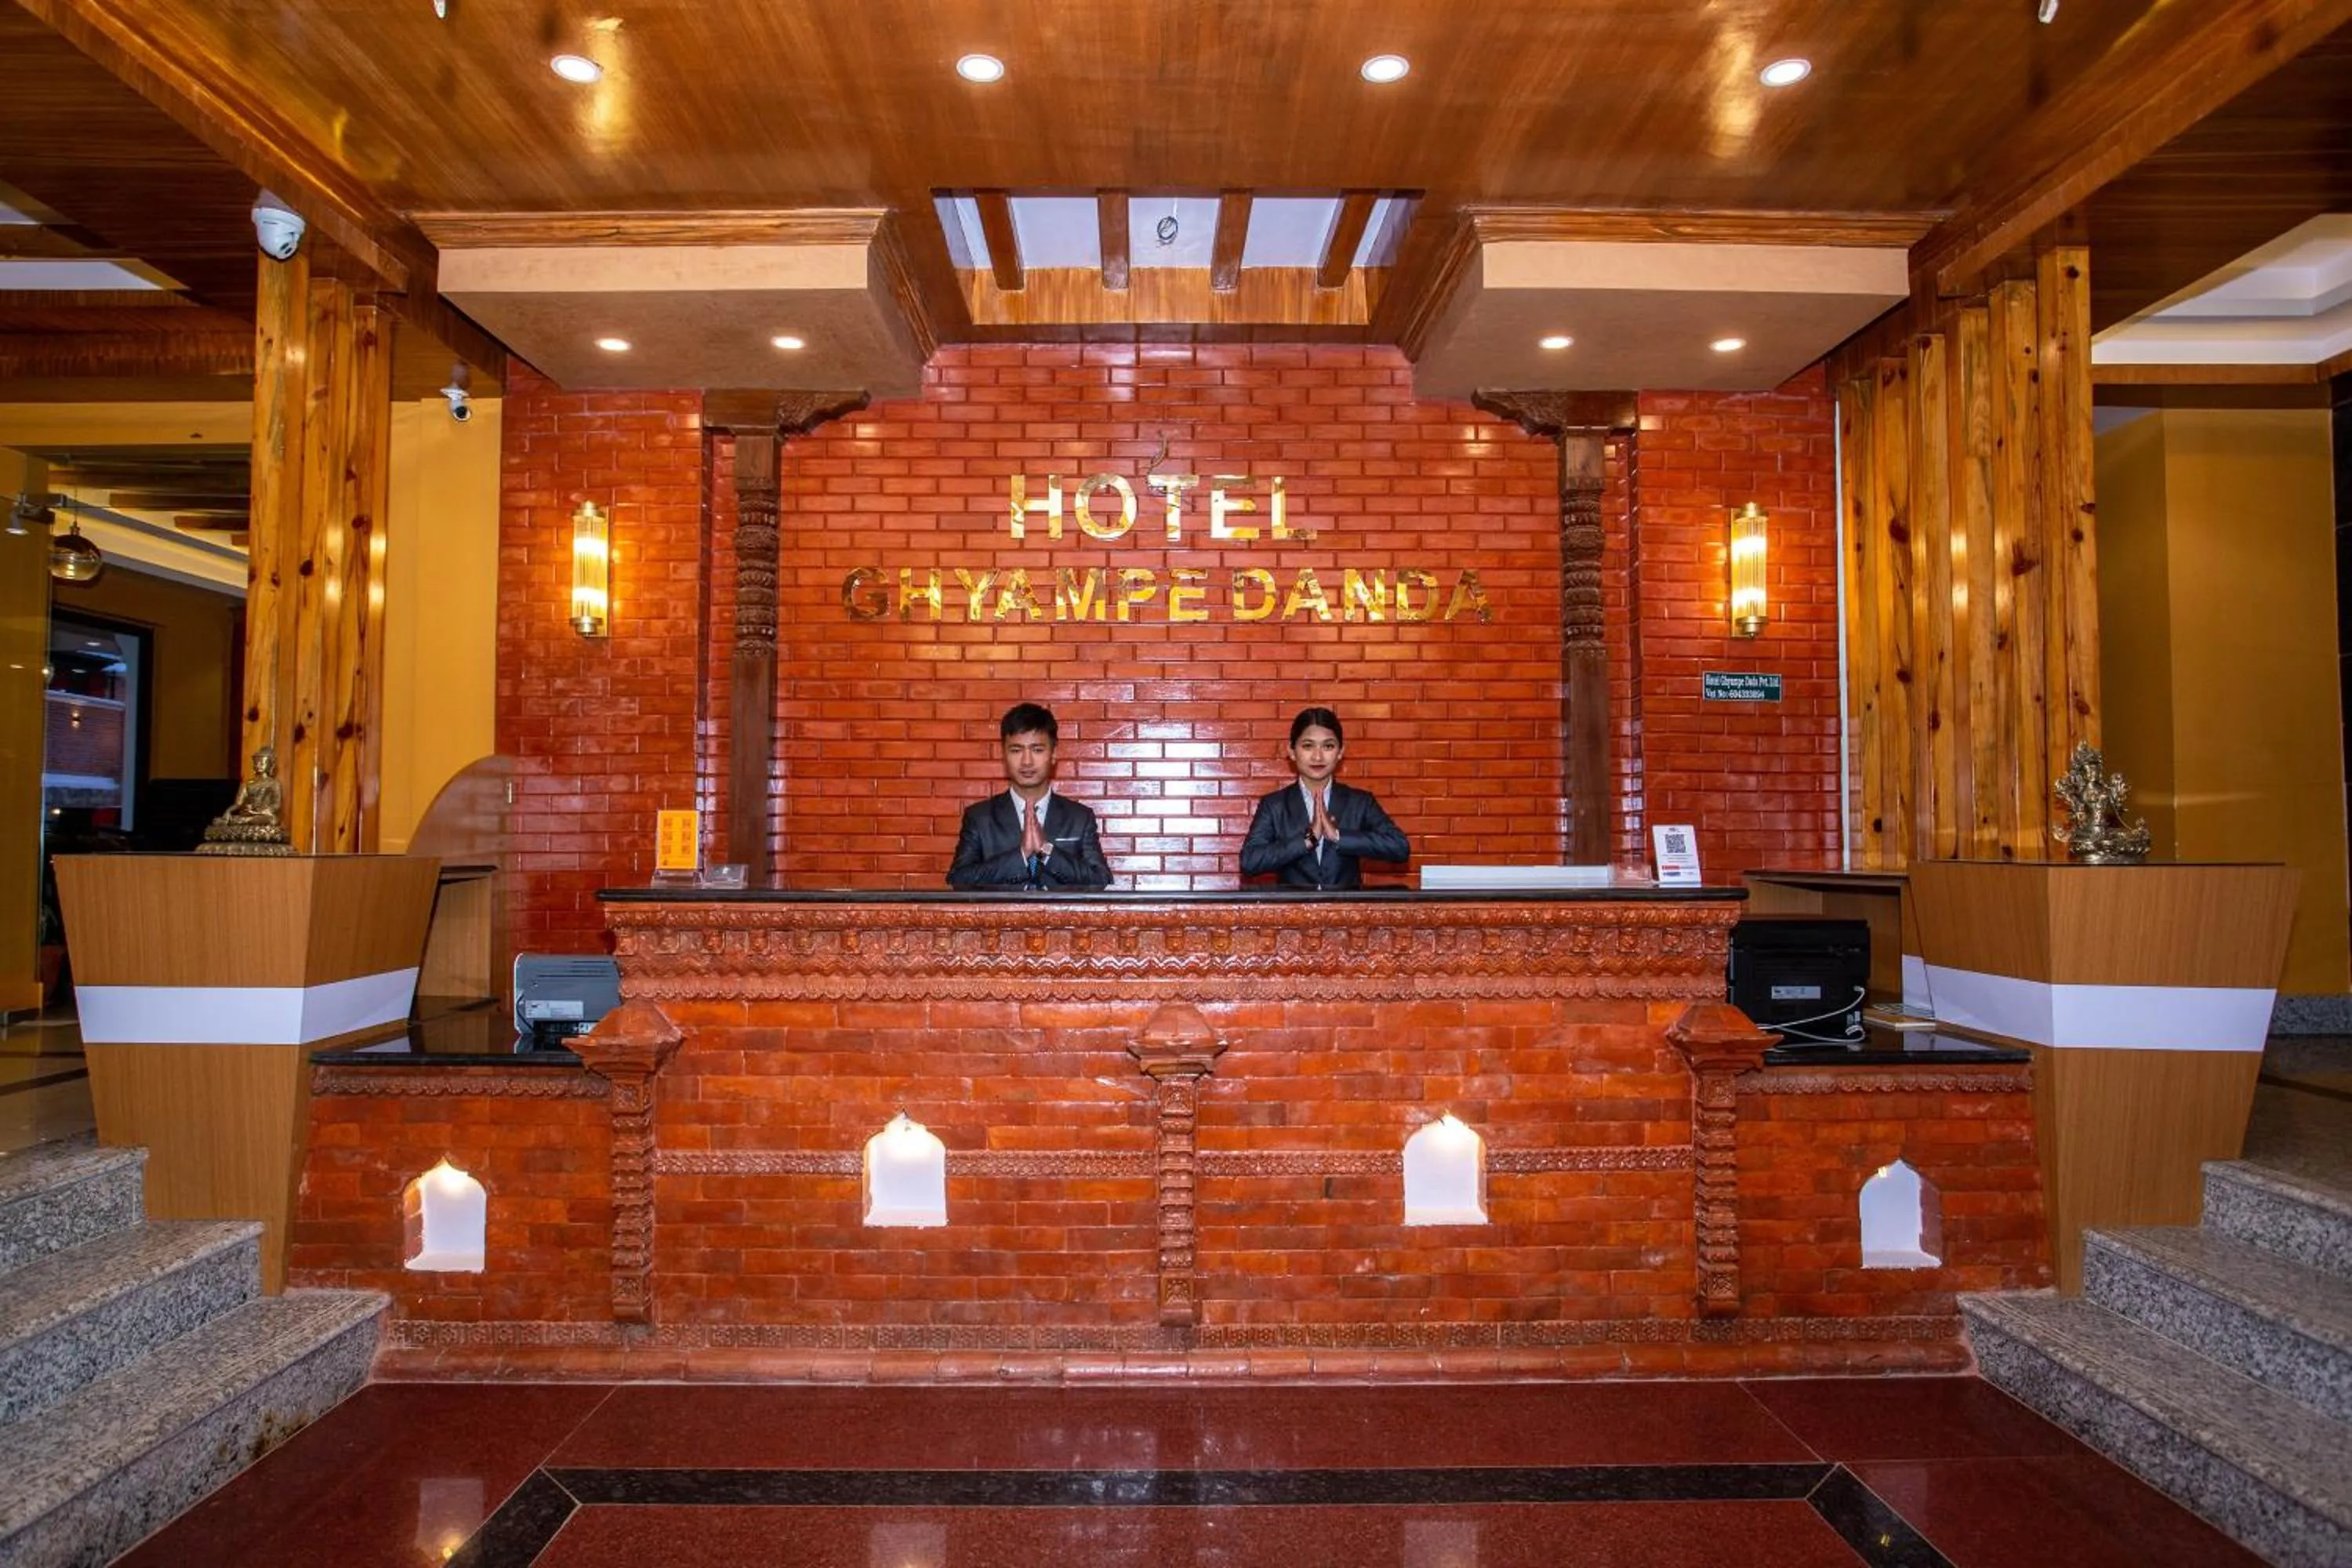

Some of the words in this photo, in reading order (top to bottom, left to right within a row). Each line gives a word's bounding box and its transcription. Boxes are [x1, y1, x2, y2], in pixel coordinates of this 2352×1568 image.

[1010, 474, 1318, 542] HOTEL
[841, 567, 1209, 622] GHYAMPE
[1232, 568, 1492, 624] DANDA
